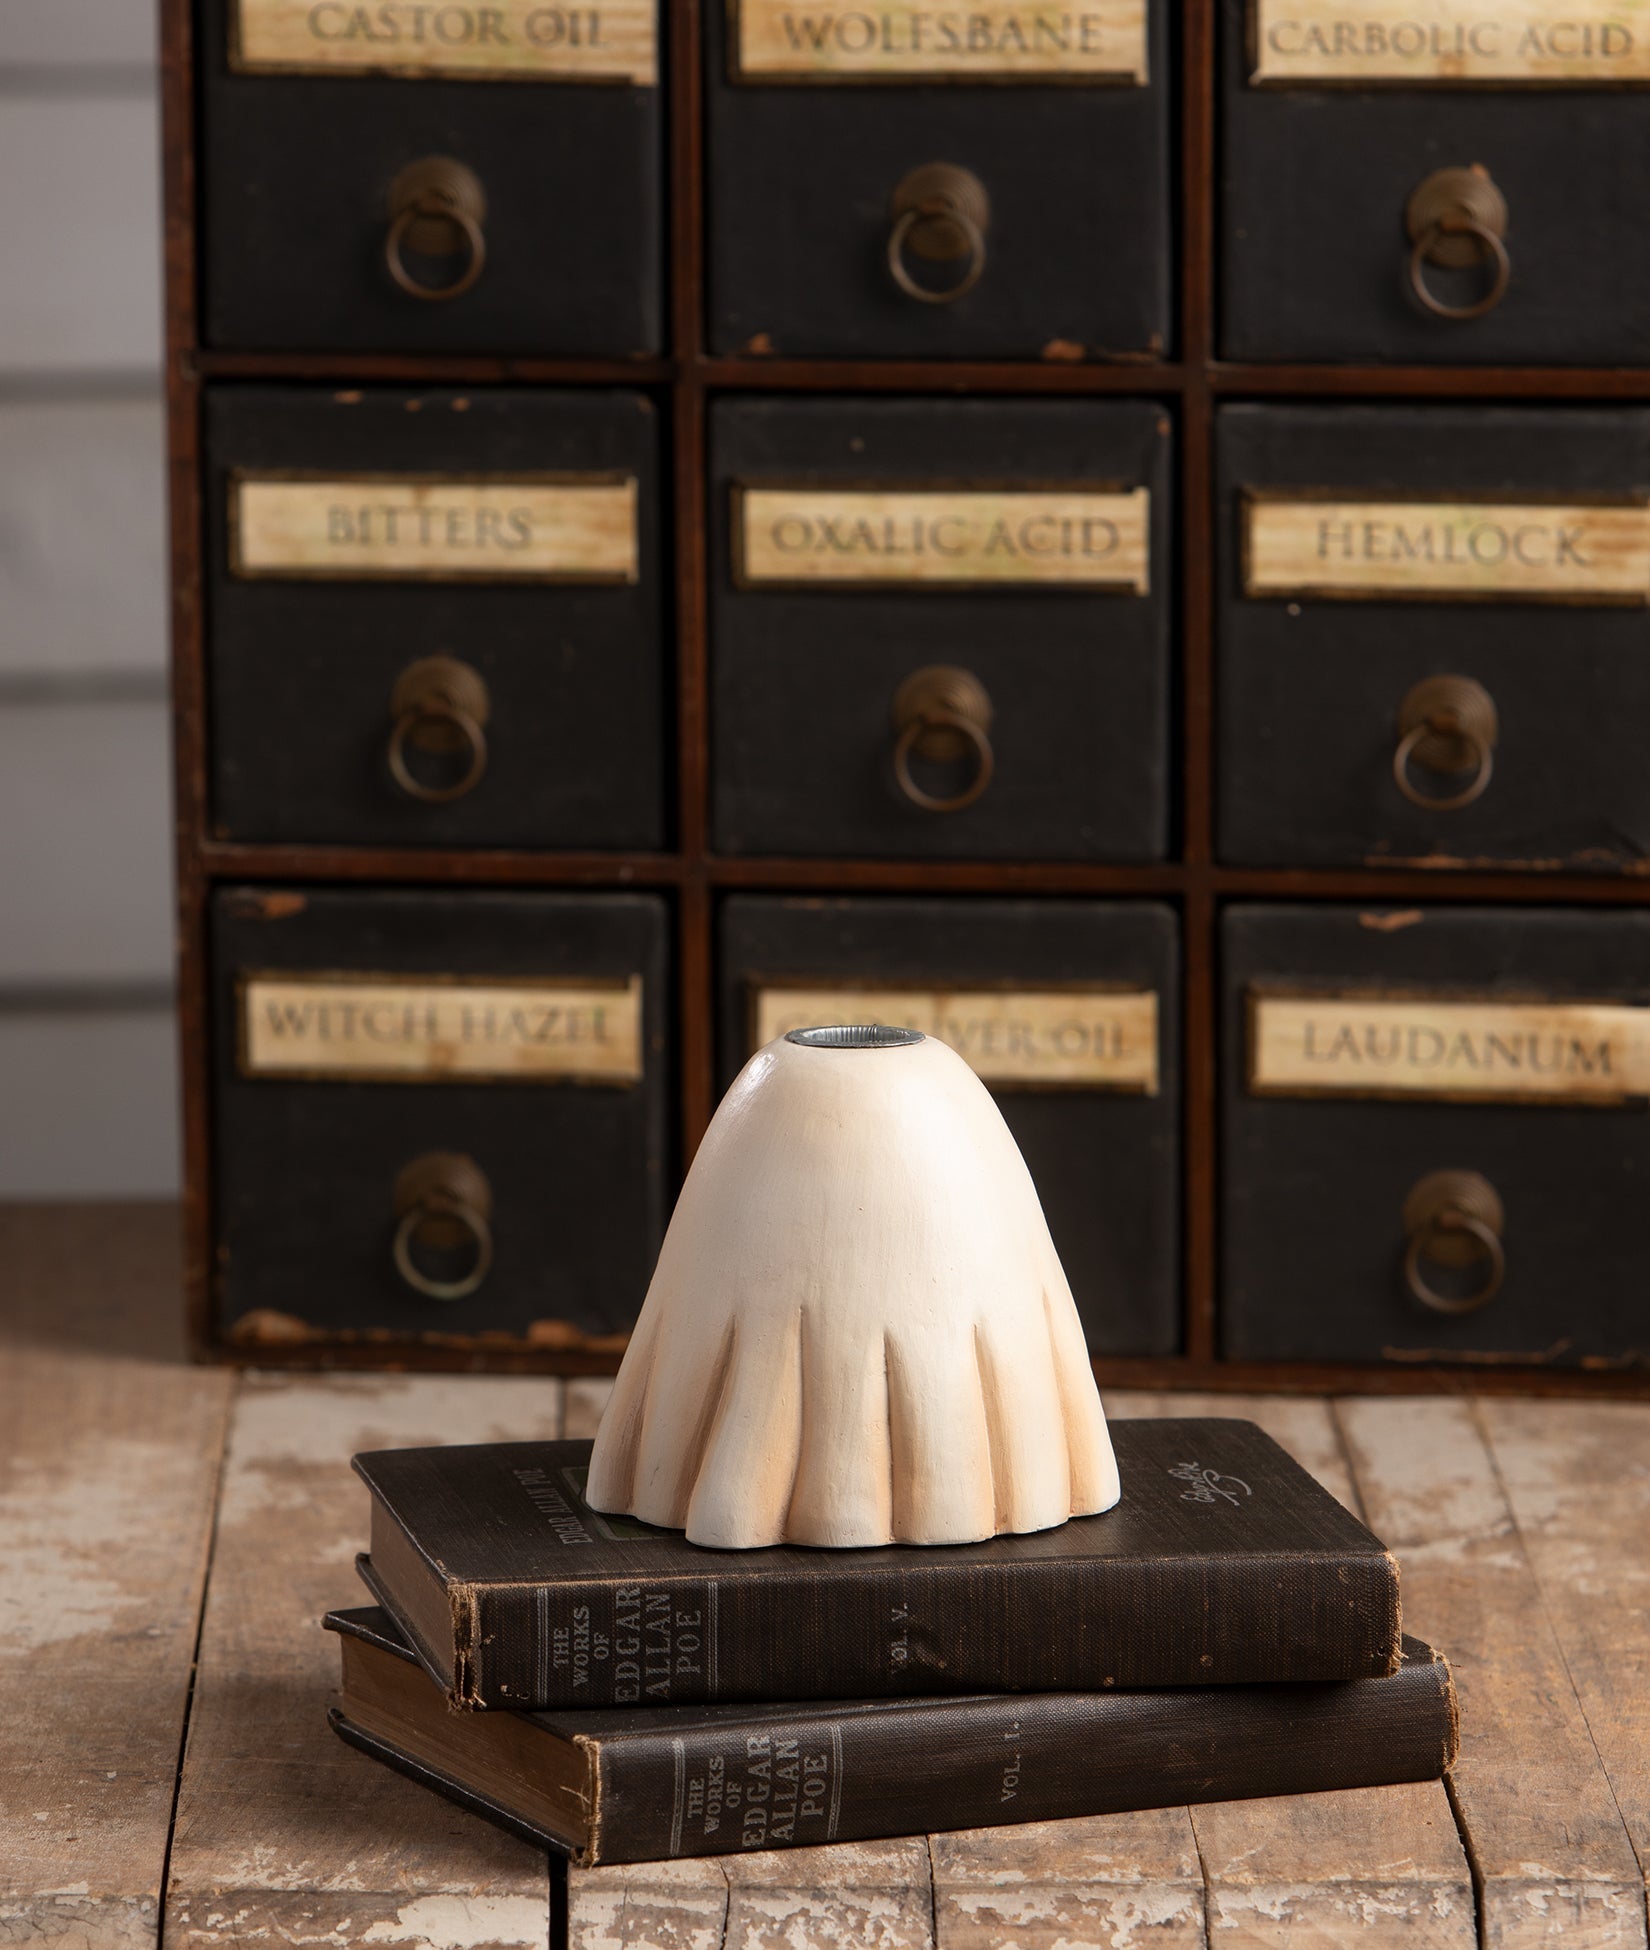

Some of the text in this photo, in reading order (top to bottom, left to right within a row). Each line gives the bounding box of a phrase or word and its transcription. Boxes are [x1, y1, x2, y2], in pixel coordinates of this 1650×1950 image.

[307, 2, 609, 50] CASTOR OIL
[782, 11, 1104, 56] WOLFSBANE
[1268, 19, 1634, 59] CARBOLIC ACID
[327, 503, 533, 551] BITTERS
[771, 512, 1120, 560] OXALIC ACID
[1316, 517, 1593, 568] HEMLOCK
[265, 1001, 614, 1045] WITCH HAZEL
[905, 1016, 1041, 1060] VER
[1053, 1018, 1132, 1061] OIL
[1302, 1020, 1612, 1075] LAUDANUM
[548, 1515, 593, 1545] EDGAR
[552, 1626, 569, 1669] THE
[573, 1605, 590, 1688] WORKS
[594, 1632, 610, 1660] OF
[615, 1587, 641, 1703] EDGAR
[646, 1593, 671, 1700] ALLAN
[676, 1610, 701, 1675] POE
[687, 1777, 706, 1819] THE
[704, 1755, 725, 1836] WORKS
[725, 1781, 742, 1808] OF
[742, 1735, 771, 1848] EDGAR
[770, 1738, 800, 1842] ALLAN
[801, 1754, 828, 1817] POE
[1000, 1754, 1021, 1802] VOL.
